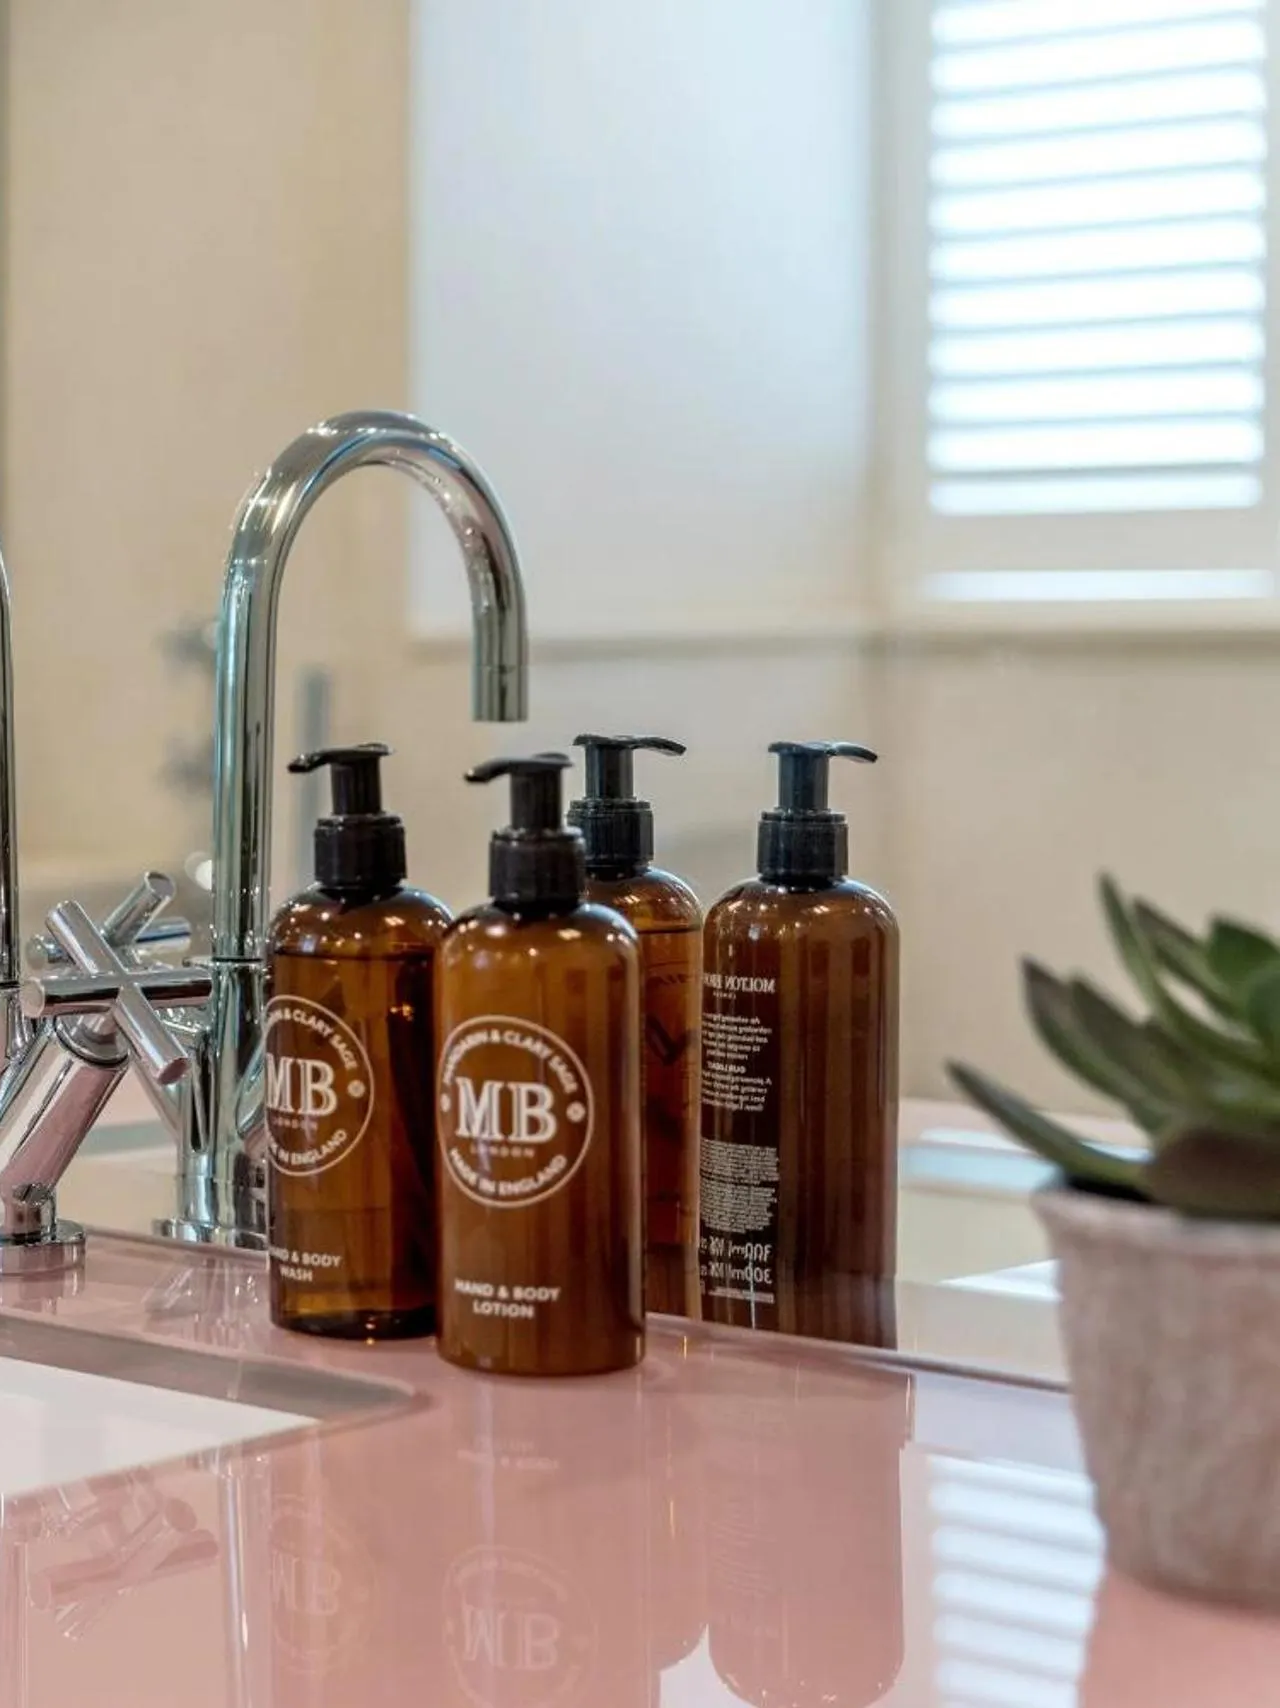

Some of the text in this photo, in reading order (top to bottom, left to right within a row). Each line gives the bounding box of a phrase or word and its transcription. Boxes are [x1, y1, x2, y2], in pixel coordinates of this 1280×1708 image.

[292, 1009, 335, 1038] CLARY
[329, 1033, 359, 1071] SAGE
[503, 1031, 553, 1060] CLARY
[548, 1055, 579, 1094] SAGE
[266, 1052, 338, 1117] MB
[454, 1075, 558, 1144] MB
[290, 1128, 348, 1166] ENGLAND
[450, 1148, 568, 1197] MADE IN ENGLAND
[279, 1263, 313, 1282] WASH
[301, 1251, 342, 1268] BODY
[453, 1277, 561, 1302] HAND & BODY
[472, 1299, 535, 1318] LOTION
